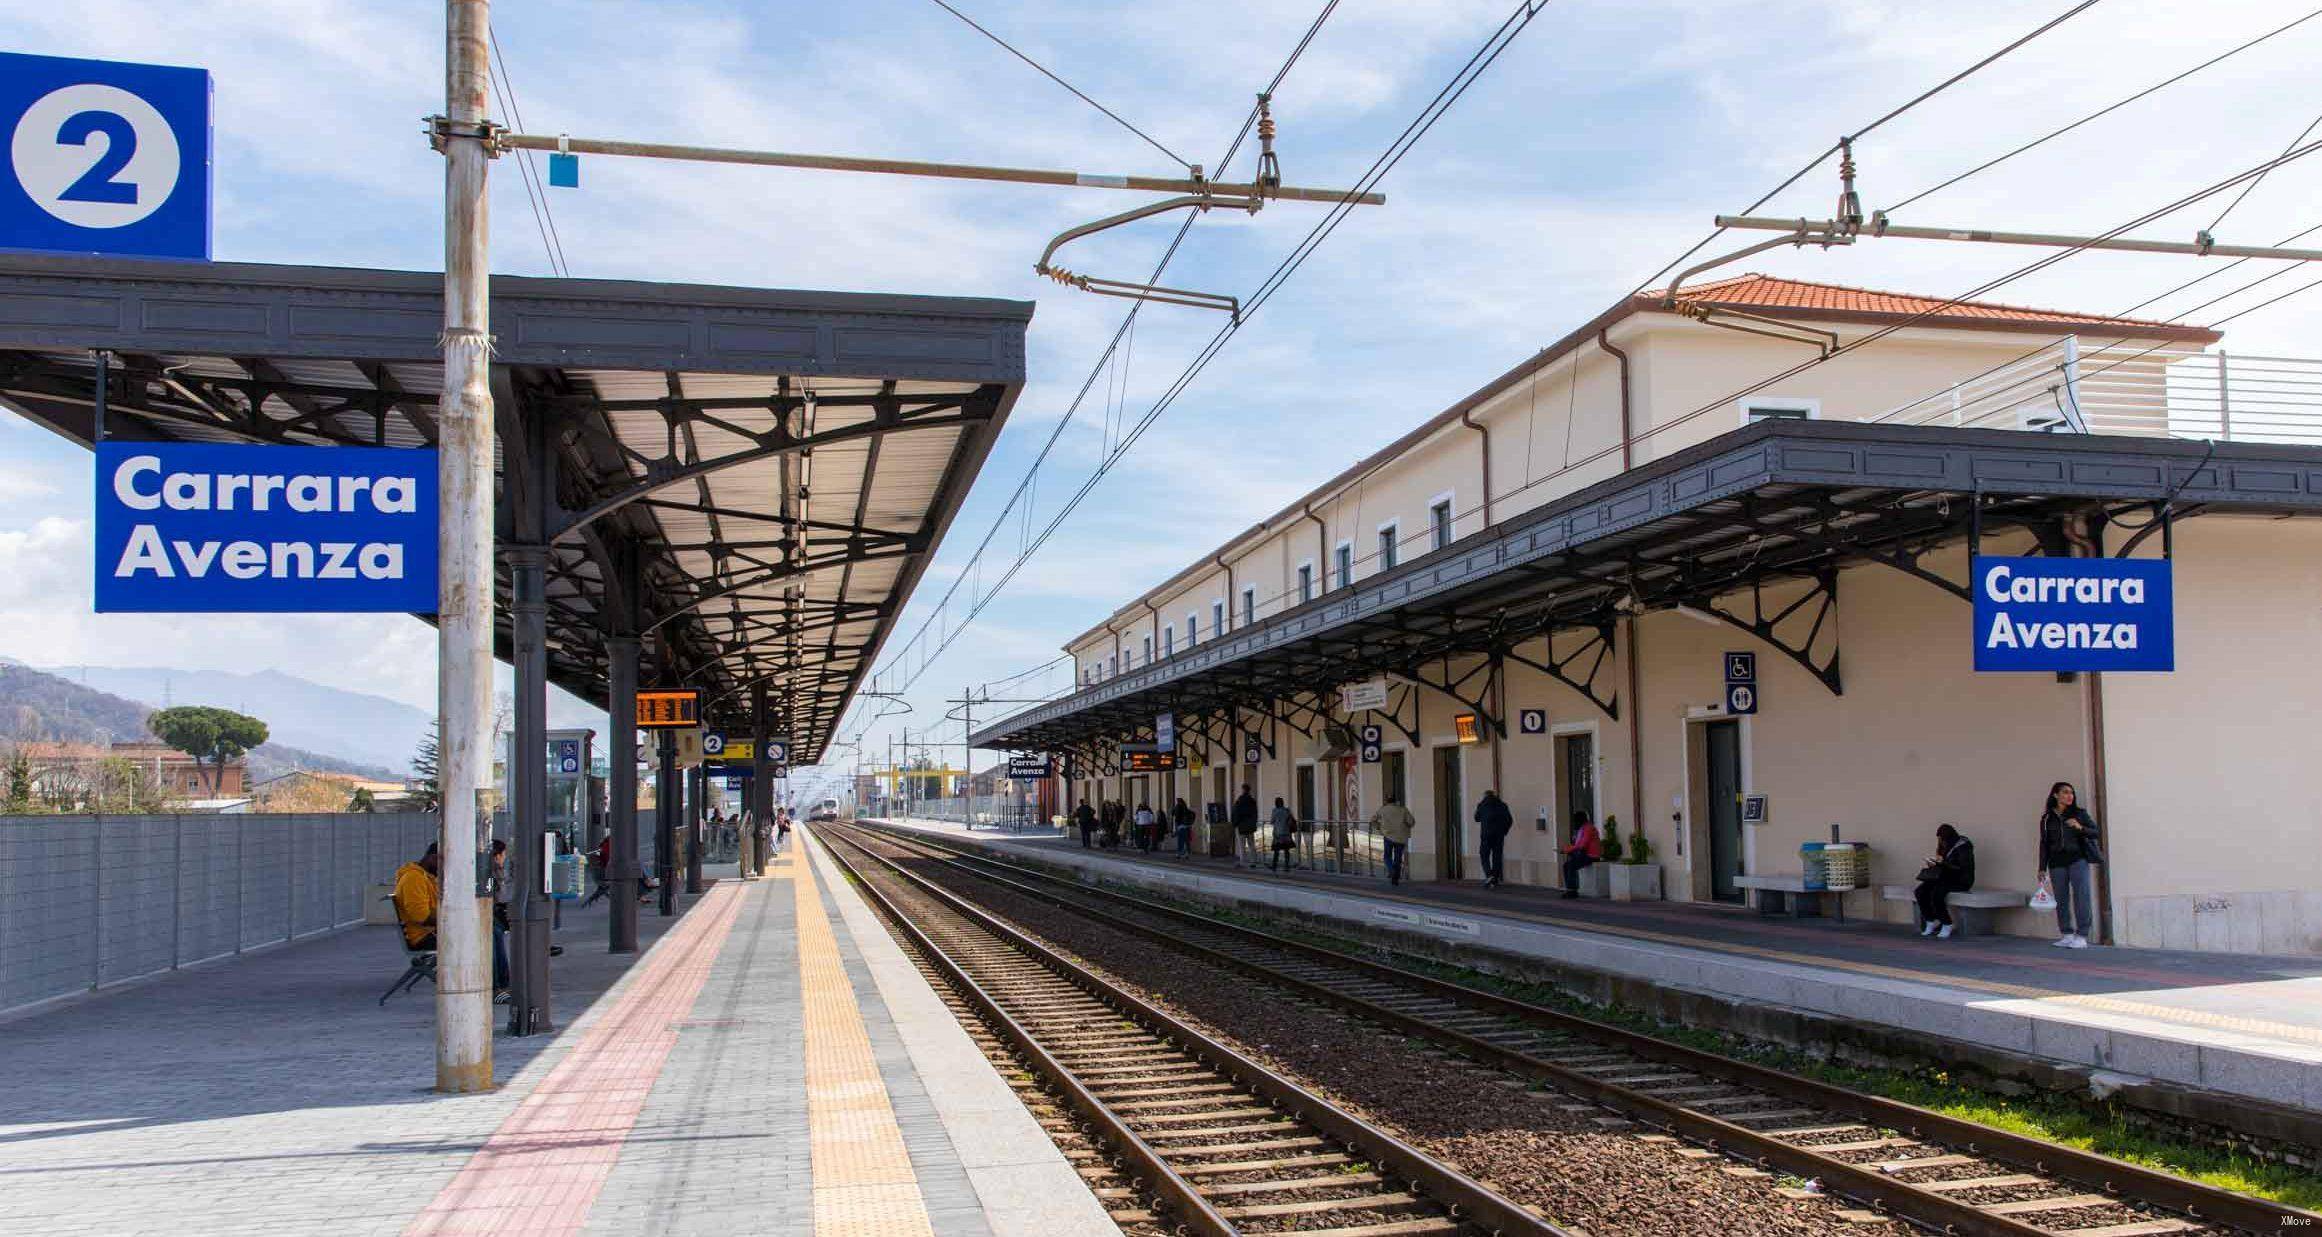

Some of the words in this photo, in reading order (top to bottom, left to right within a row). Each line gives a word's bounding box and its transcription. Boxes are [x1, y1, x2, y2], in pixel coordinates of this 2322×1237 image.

[56, 110, 139, 205] 2
[113, 455, 417, 513] Carrara
[113, 524, 405, 580] Avenza
[1985, 565, 2145, 604] Carrara
[1986, 612, 2138, 649] Avenza
[1529, 716, 1535, 728] 1
[708, 738, 717, 749] 2
[1010, 767, 1046, 775] Avenza
